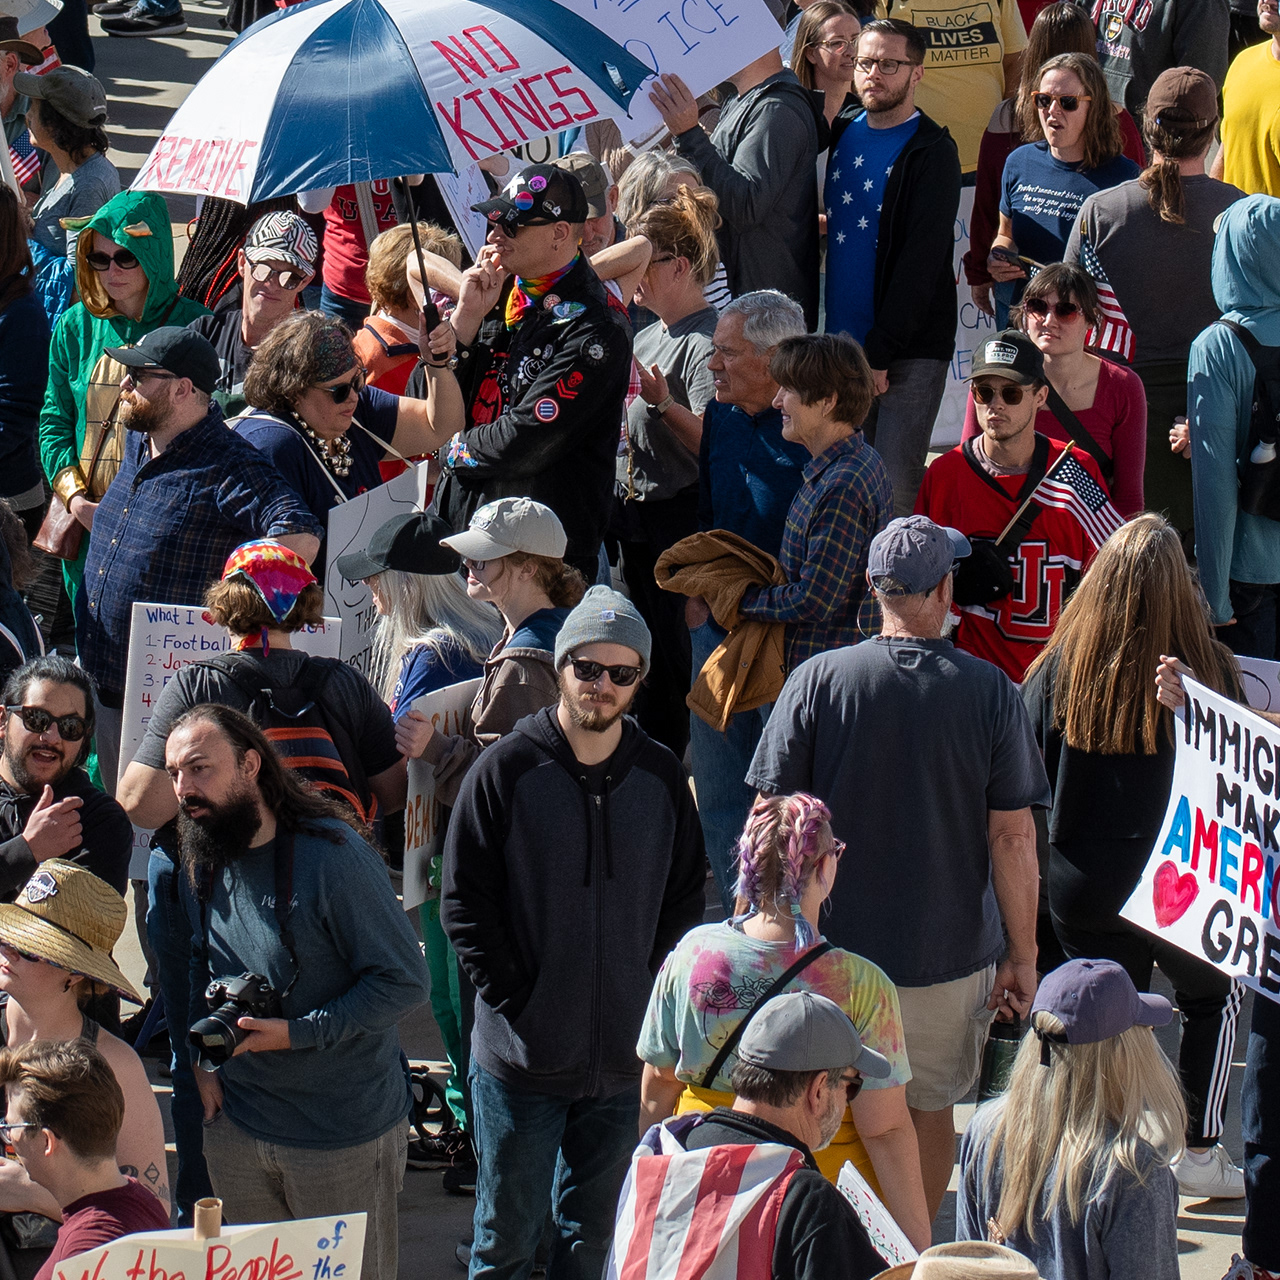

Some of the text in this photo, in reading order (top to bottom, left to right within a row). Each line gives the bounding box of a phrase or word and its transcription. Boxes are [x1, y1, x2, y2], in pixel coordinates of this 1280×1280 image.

[926, 11, 978, 27] BLACK
[930, 29, 983, 45] LIVES
[431, 25, 519, 85] NO
[931, 46, 990, 62] MATTER
[436, 65, 599, 161] KINGS
[146, 608, 195, 626] What I
[317, 1220, 347, 1249] of
